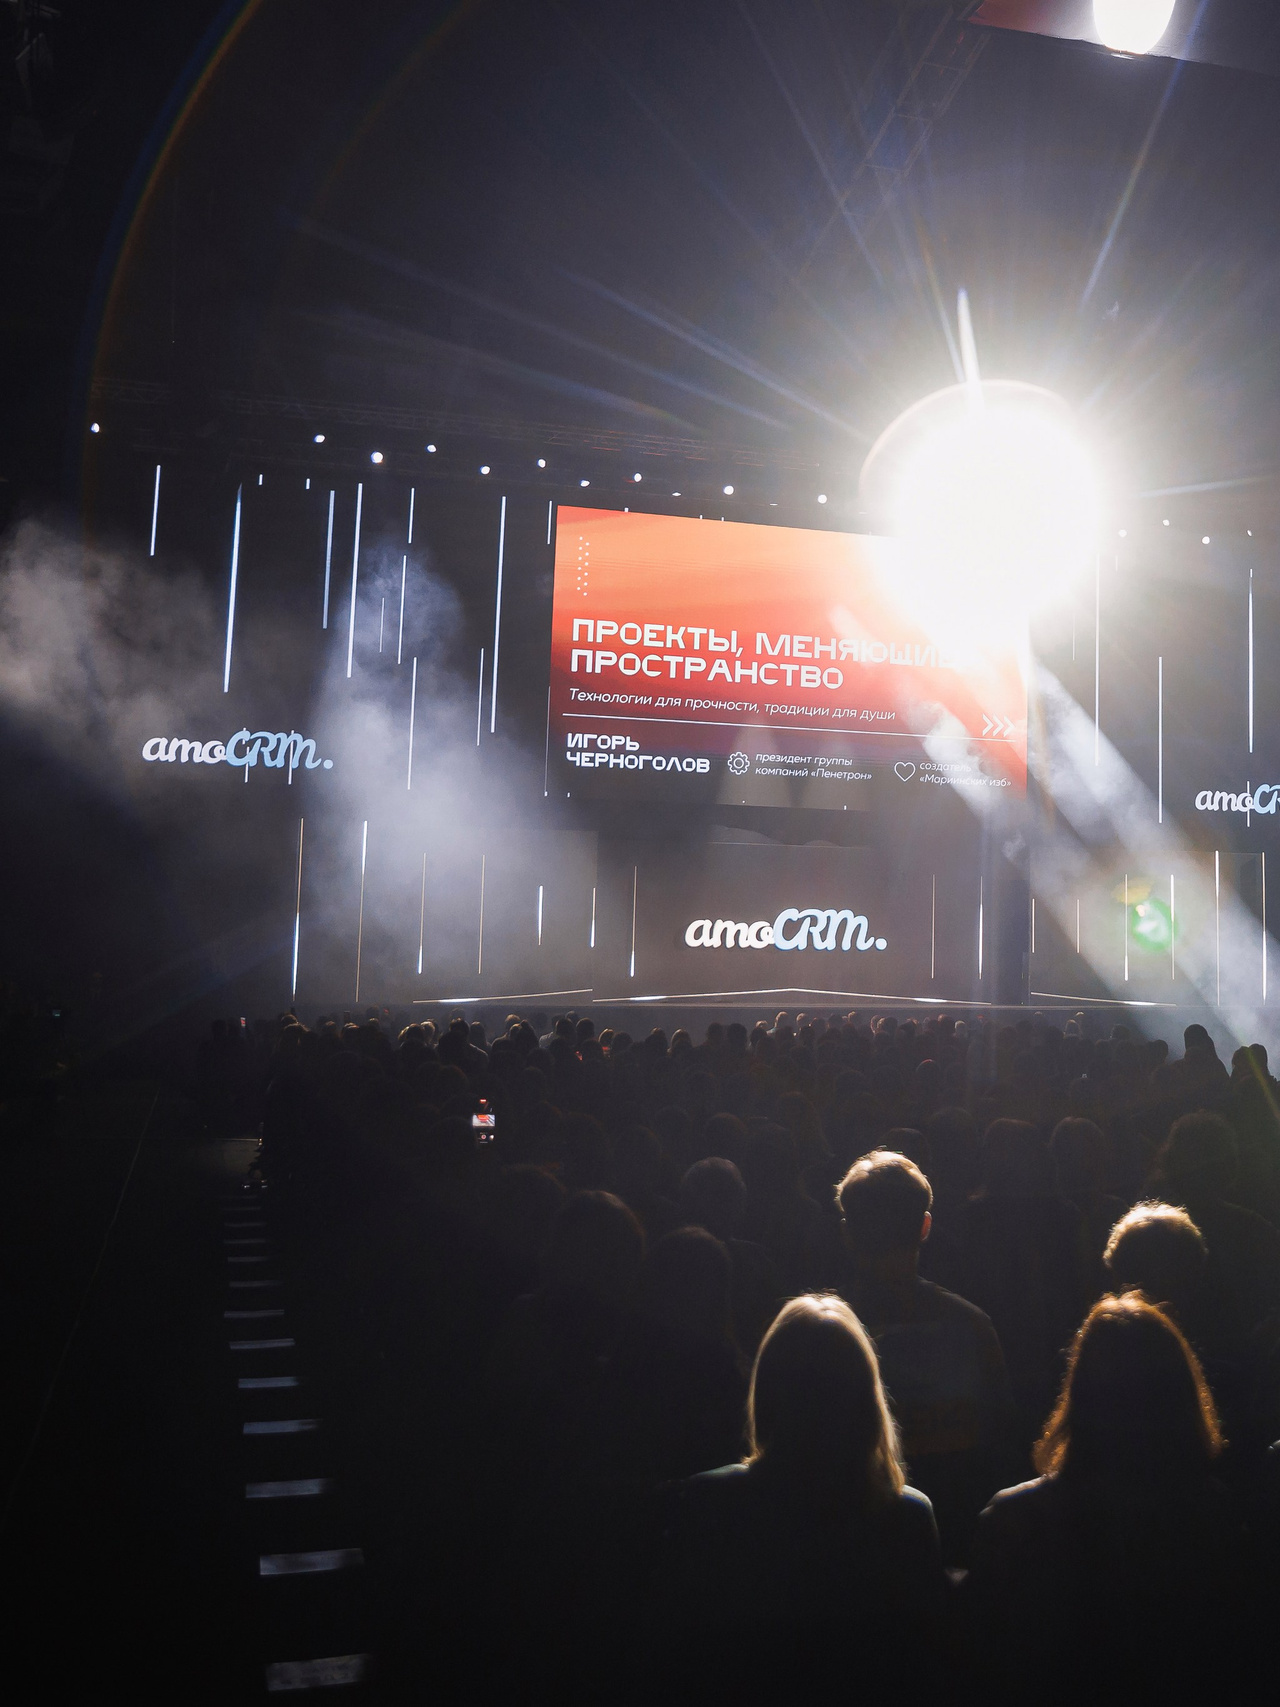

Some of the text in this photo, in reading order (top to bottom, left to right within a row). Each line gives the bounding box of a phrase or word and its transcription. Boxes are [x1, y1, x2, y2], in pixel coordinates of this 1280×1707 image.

[572, 618, 743, 658] ПРОЕКТЫ,
[570, 648, 844, 690] ПРОСТРАНСТВО
[569, 687, 896, 722] Технологии для прочности, традиции для души
[566, 732, 640, 751] ИГОРЬ
[566, 751, 711, 774] ЧЕРНОГОЛОВ
[755, 752, 853, 767] президент группы
[755, 767, 872, 782] компаний «Пенетрон»
[684, 908, 888, 951] amoCRM.
